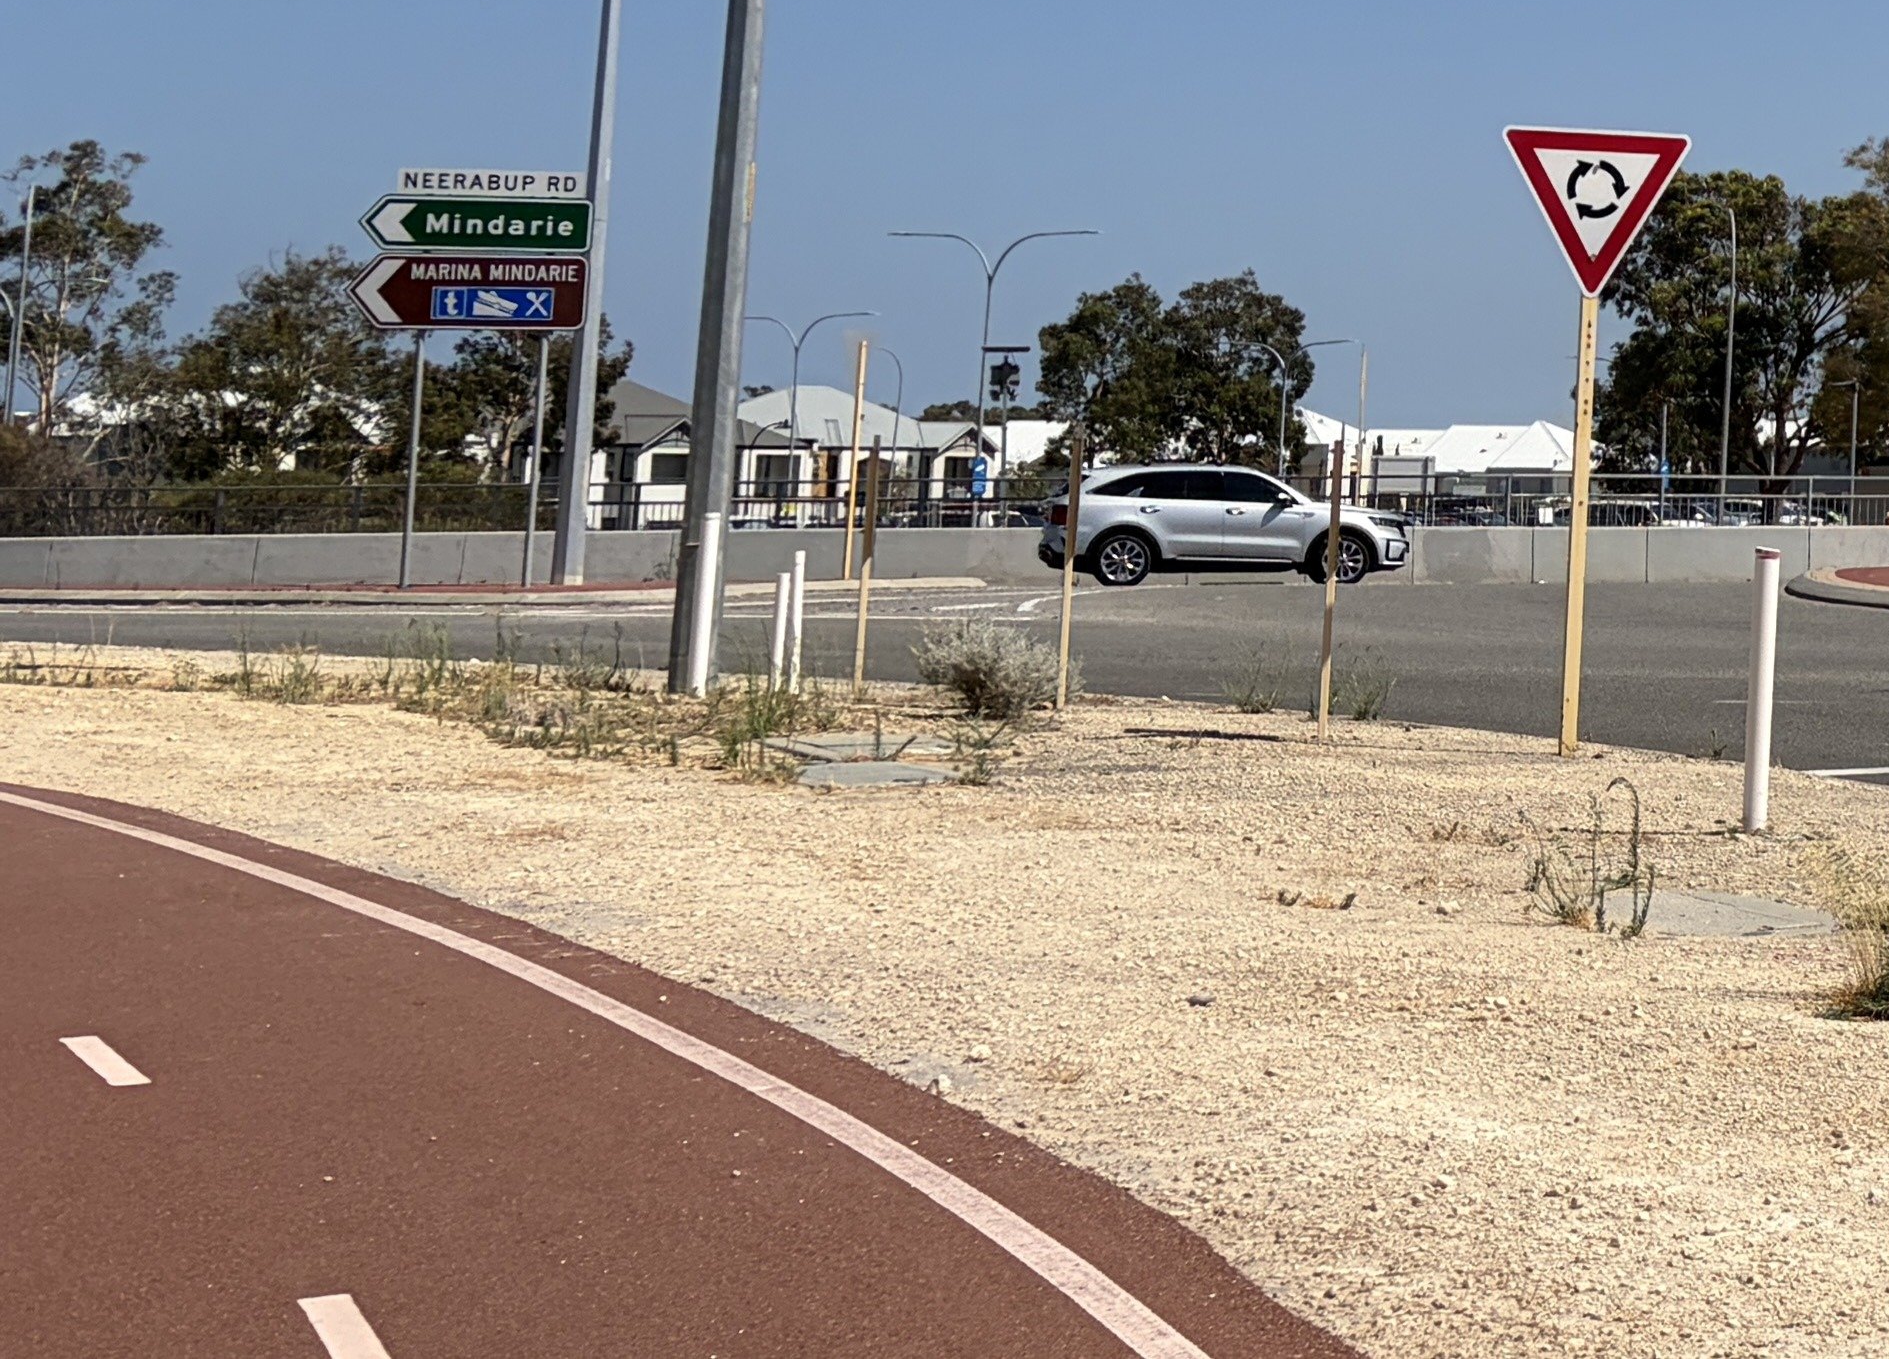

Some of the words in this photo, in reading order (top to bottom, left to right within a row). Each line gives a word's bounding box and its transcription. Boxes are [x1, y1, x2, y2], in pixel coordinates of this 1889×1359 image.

[404, 172, 536, 191] NEERABUP
[547, 176, 577, 192] RD
[425, 212, 574, 236] Mindarie
[410, 263, 482, 281] MARINA
[489, 264, 579, 282] MINDARIE
